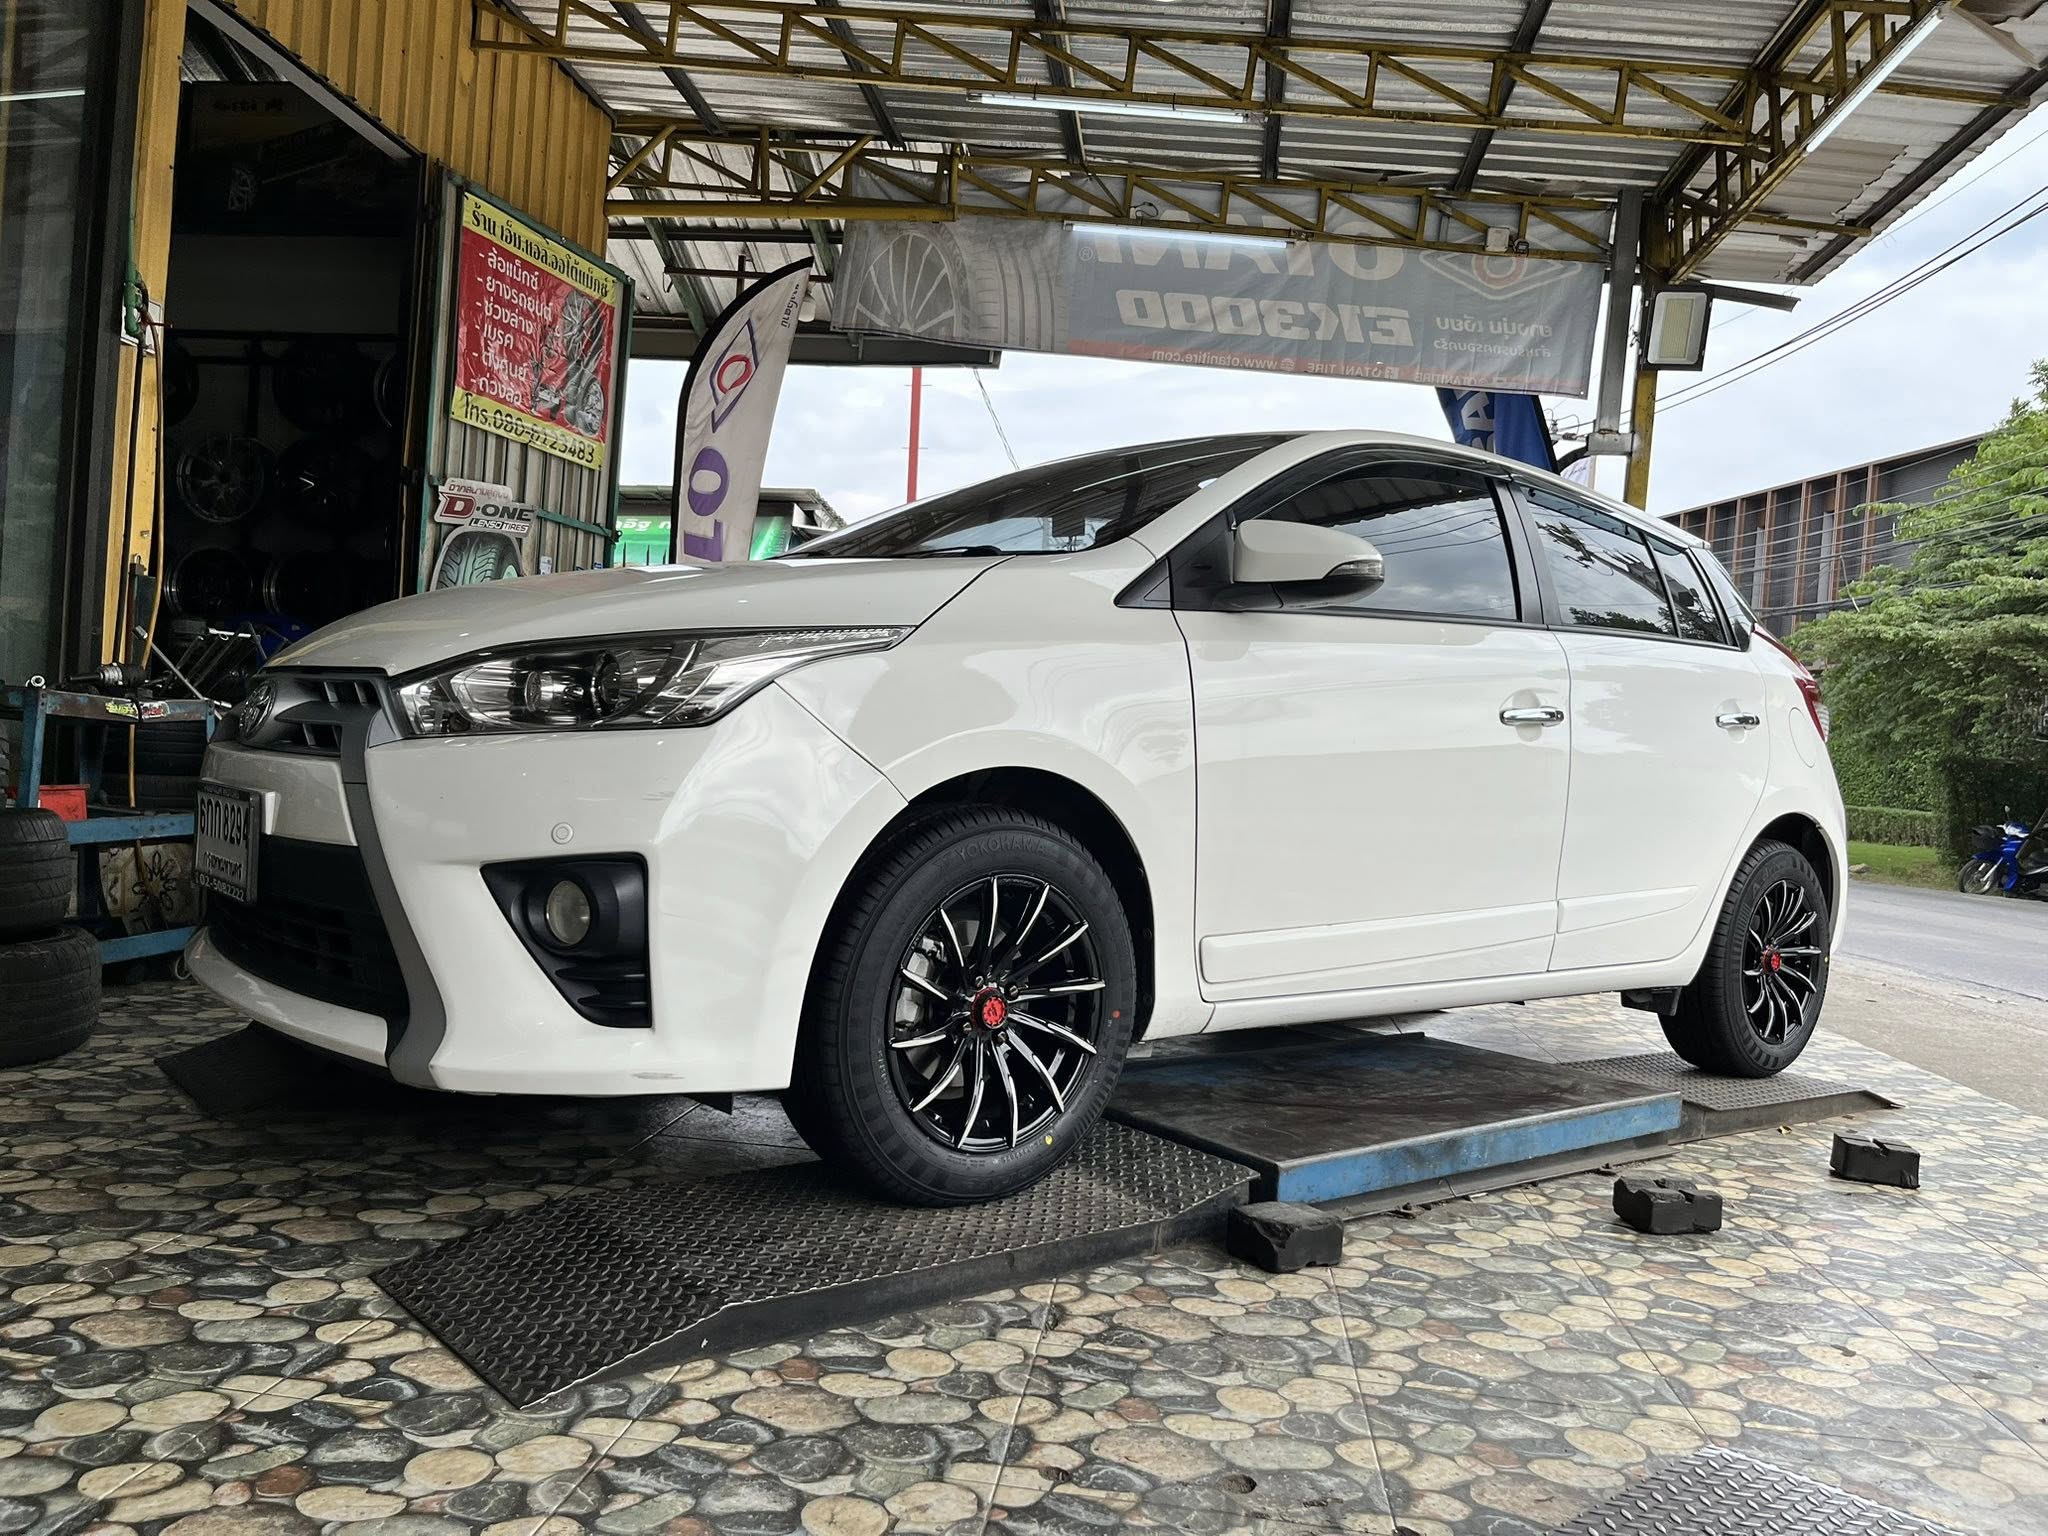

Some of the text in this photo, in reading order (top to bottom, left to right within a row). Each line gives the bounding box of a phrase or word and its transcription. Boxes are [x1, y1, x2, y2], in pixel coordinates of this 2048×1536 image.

[472, 202, 496, 236] ร้าน
[487, 247, 539, 290] ล้อแม็กซ์
[484, 296, 533, 335] ช่วงล่าง
[486, 276, 553, 322] ยางรถยนต์
[483, 323, 514, 350] เบรค
[479, 371, 523, 406] ถ่วงล้อ
[200, 797, 248, 848] 6กก 8294
[955, 835, 1048, 863] YOKOHAMA
